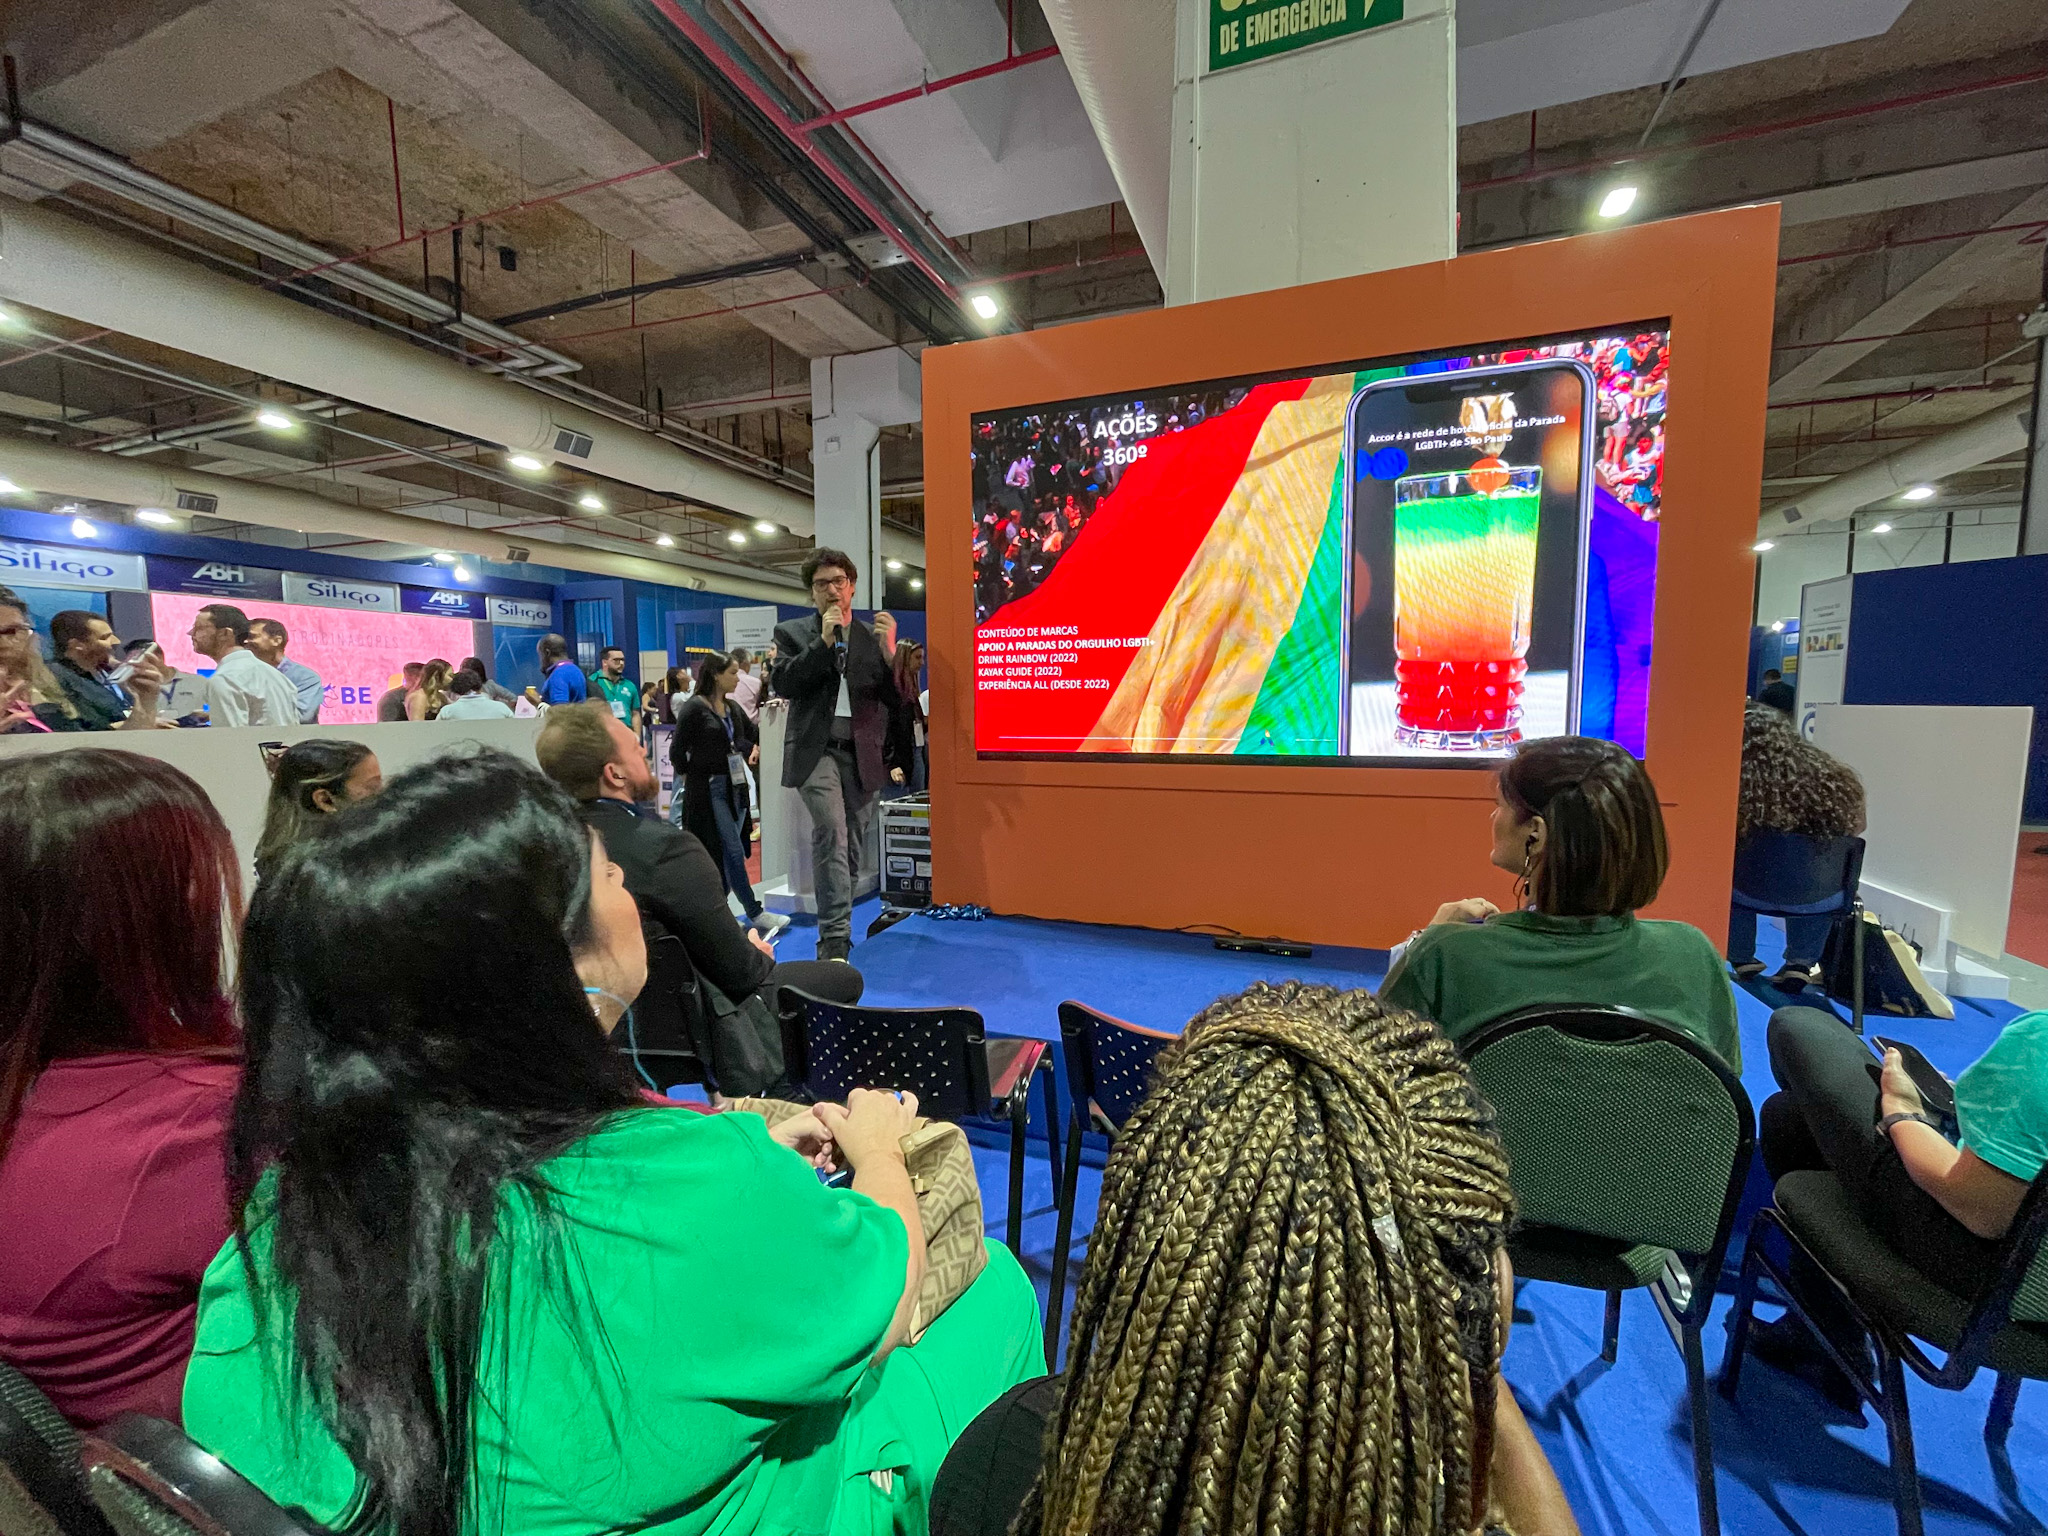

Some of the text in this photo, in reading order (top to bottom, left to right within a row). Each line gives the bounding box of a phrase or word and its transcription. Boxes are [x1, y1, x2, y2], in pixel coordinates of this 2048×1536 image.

[1220, 20, 1239, 55] DE
[1094, 413, 1158, 440] AÇÕES
[1368, 434, 1395, 444] Accor
[1396, 431, 1403, 440] é
[1412, 428, 1434, 438] rede
[1436, 427, 1448, 436] de
[1514, 419, 1528, 428] da
[1530, 415, 1566, 426] Parada
[1415, 440, 1448, 450] LGBTI+
[1450, 438, 1462, 447] de
[1484, 434, 1512, 444] Paulo
[192, 562, 244, 583] ABH
[291, 630, 399, 648] TROCINADORES
[978, 626, 1078, 638] CONTEÚDO DE MARCAS
[978, 638, 1155, 652] APOIO A PARADAS DO ORGULHO LGBTI+
[978, 653, 1078, 664] DRINK RAINBOW (2022)
[978, 666, 1062, 677] KAYAK GUIDE (2022)
[978, 678, 1110, 691] EXPERIÊNCIA ALL (DESDE 2022)
